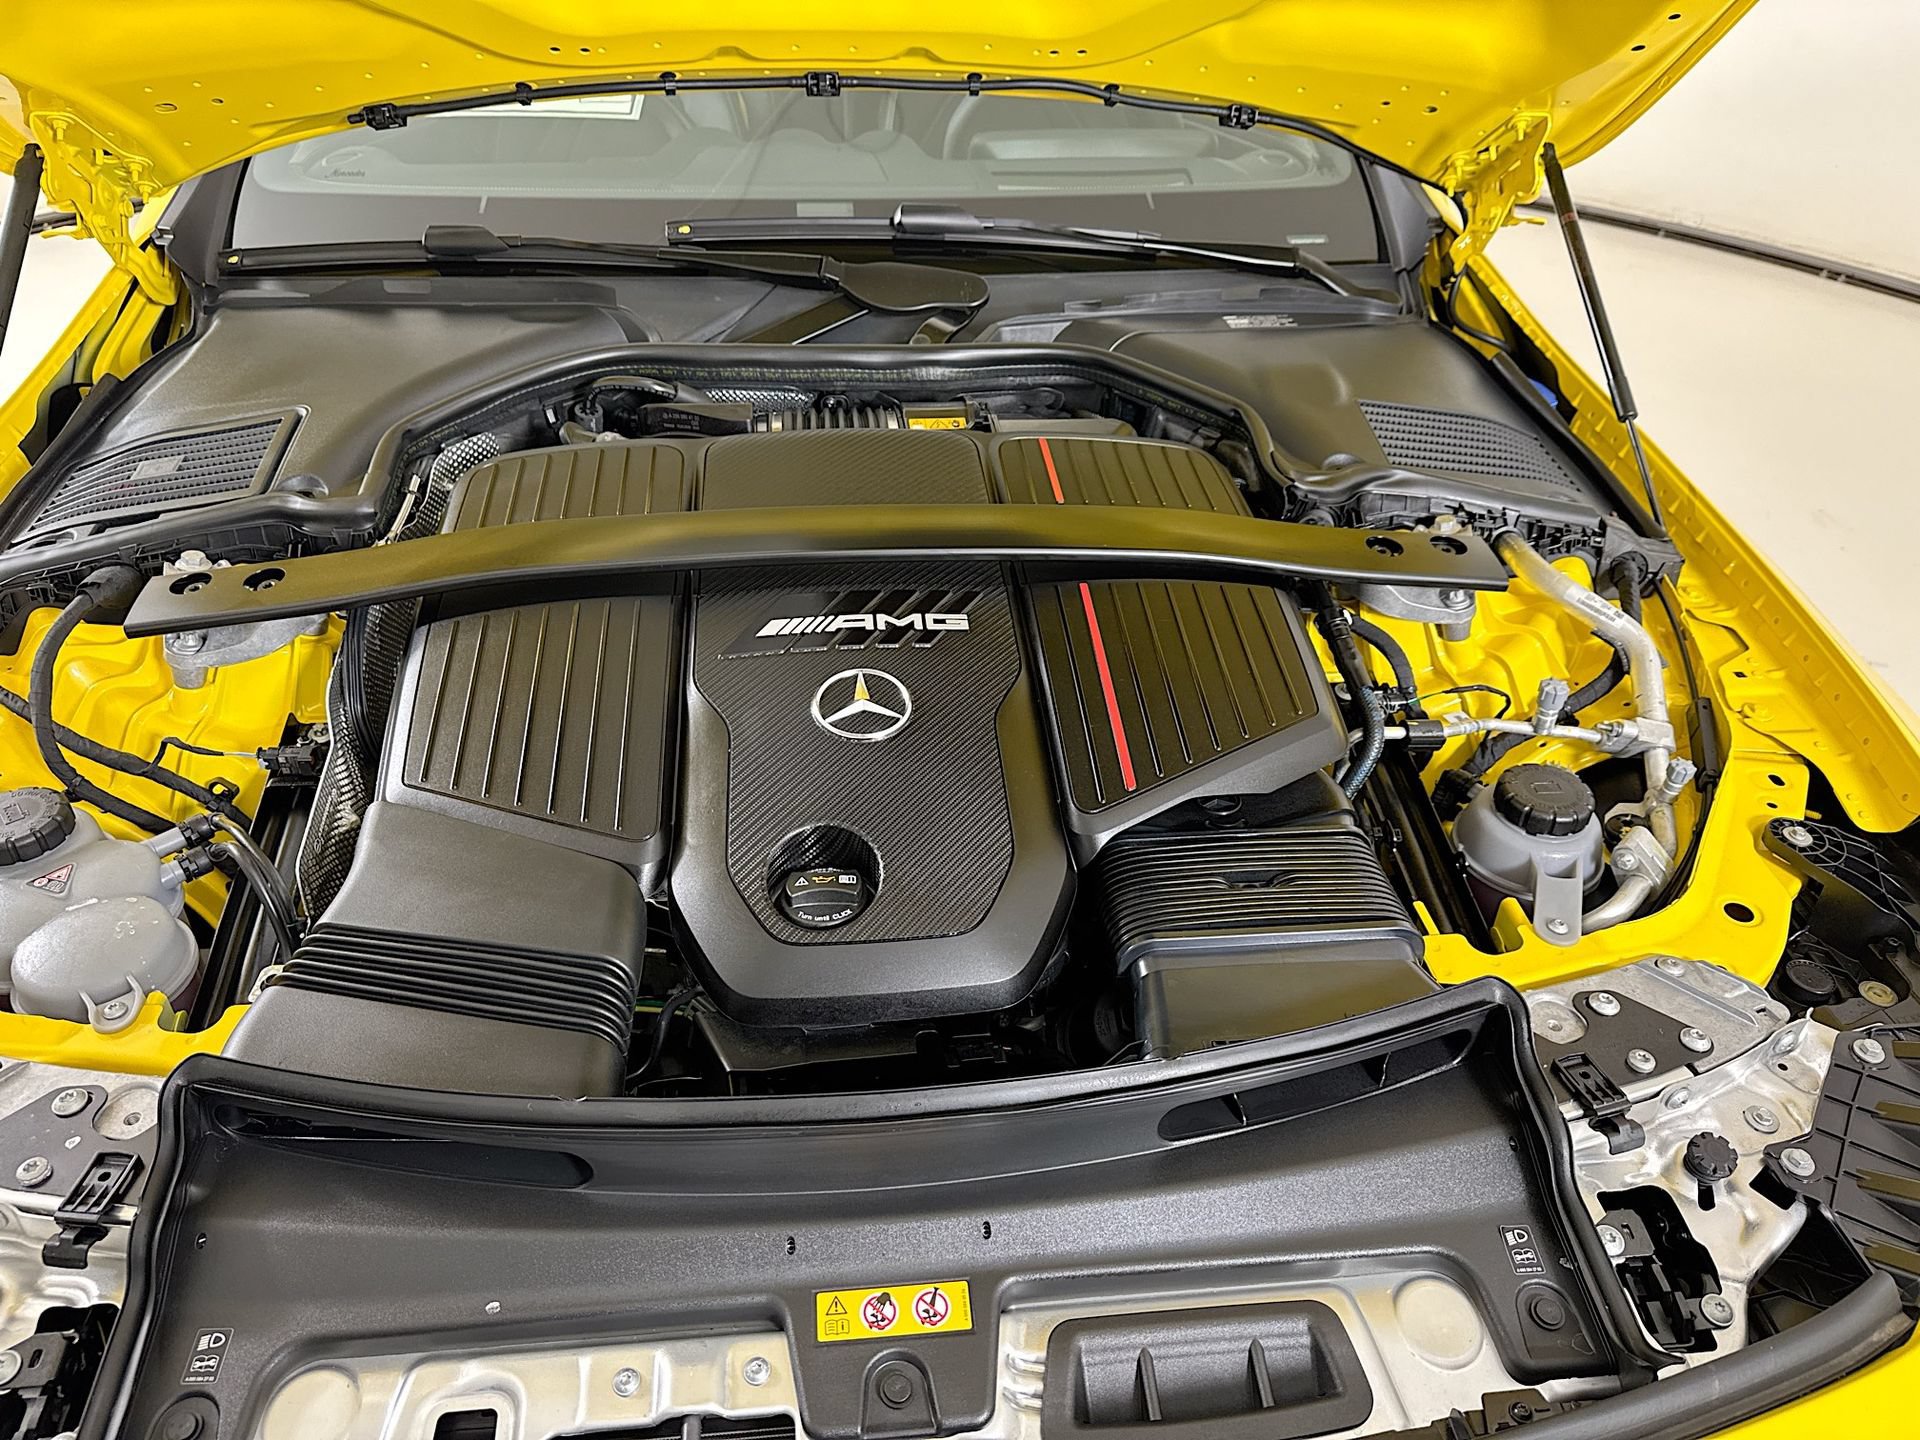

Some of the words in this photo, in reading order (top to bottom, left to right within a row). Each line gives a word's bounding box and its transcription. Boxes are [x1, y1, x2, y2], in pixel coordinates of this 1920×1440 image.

[824, 613, 970, 632] AMG
[798, 911, 812, 920] Turn
[832, 909, 852, 919] CLICK
